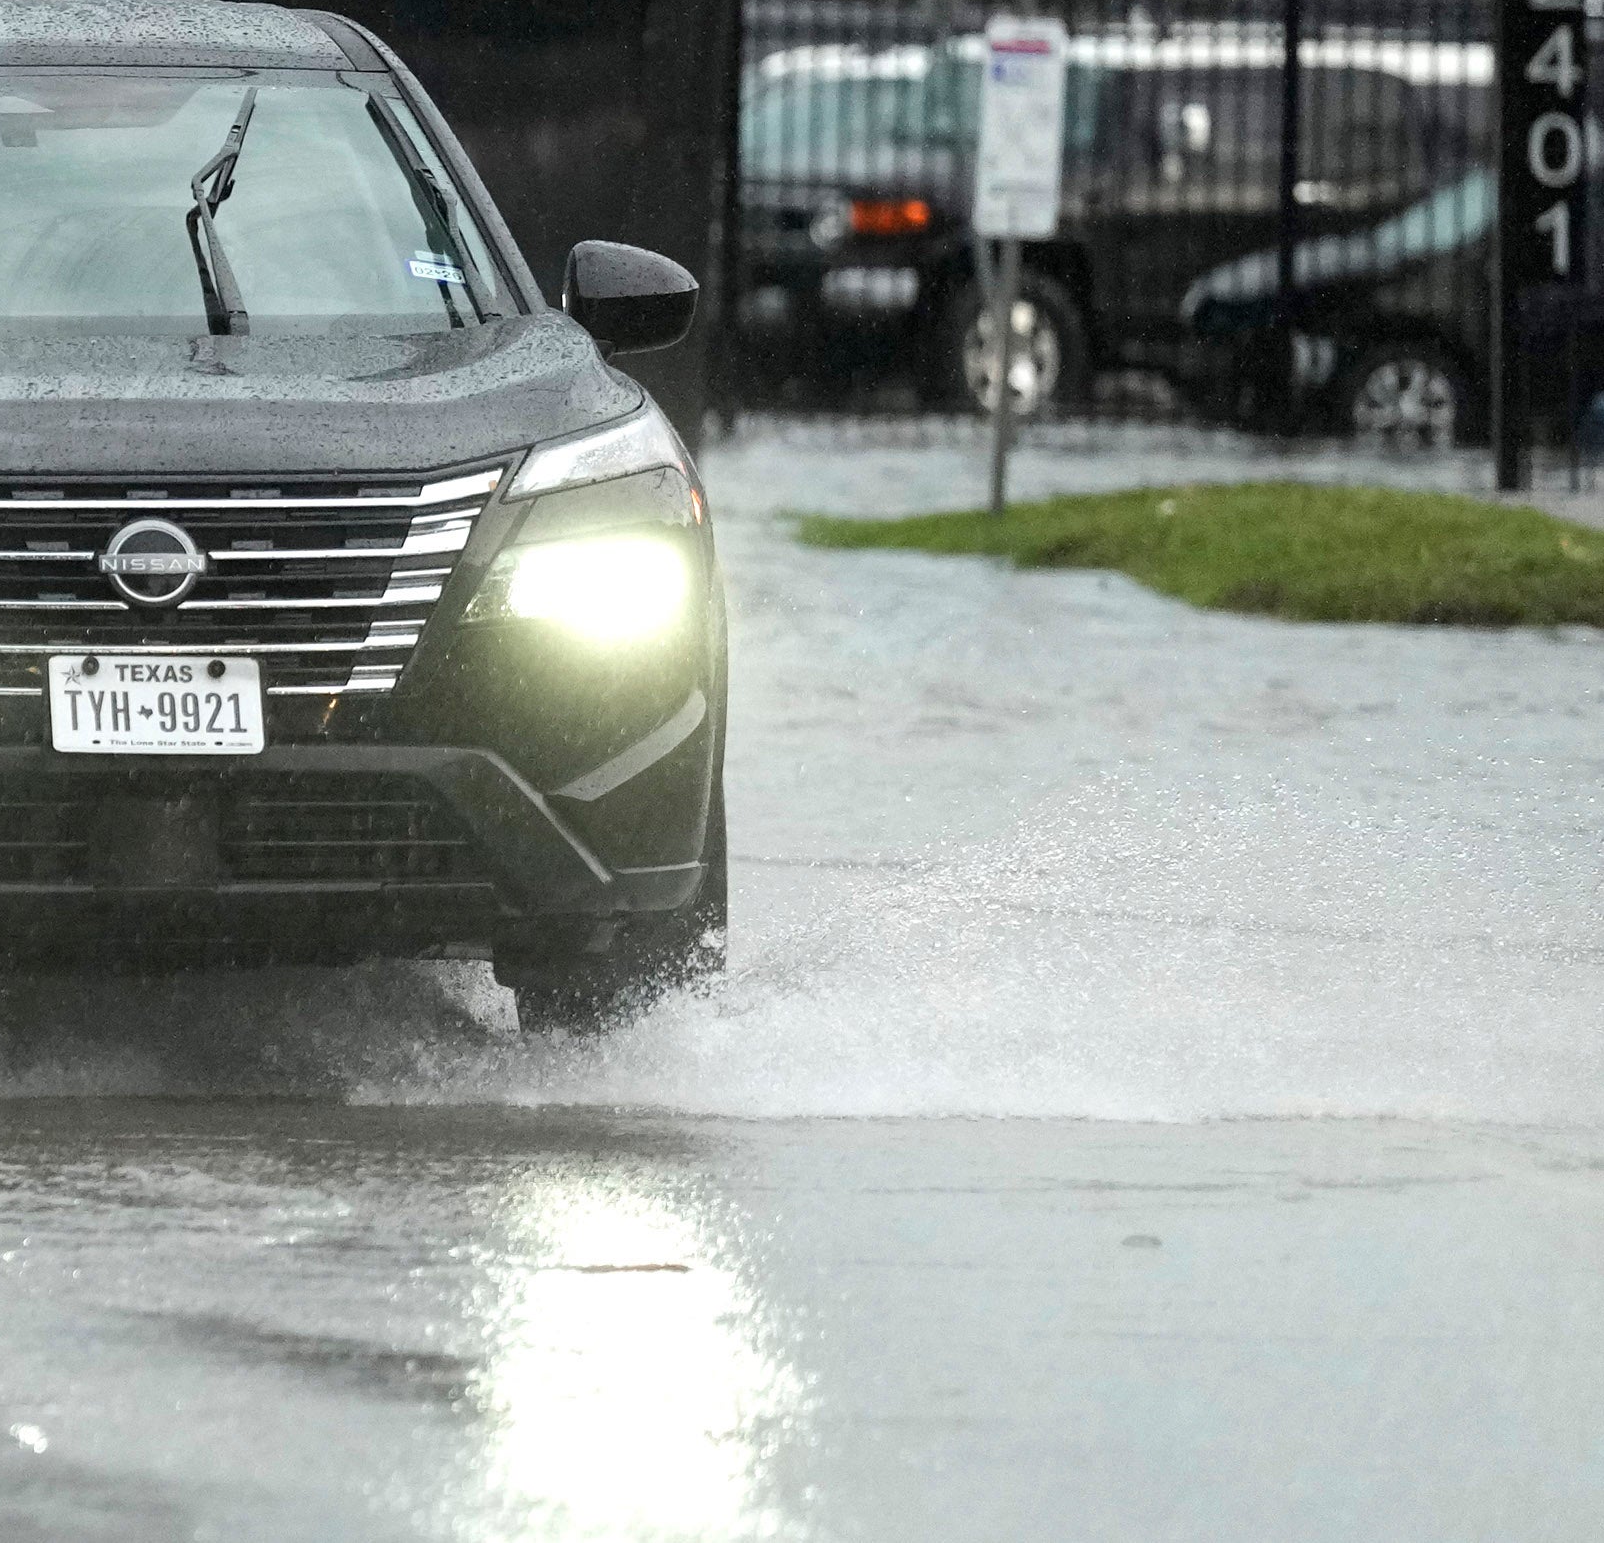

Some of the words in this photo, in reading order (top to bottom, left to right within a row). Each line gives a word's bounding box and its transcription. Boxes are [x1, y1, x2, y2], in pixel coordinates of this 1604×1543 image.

[101, 558, 204, 571] NISSAN
[115, 664, 193, 683] TEXAS
[131, 739, 154, 747] Lone
[157, 740, 177, 748] Star
[181, 740, 206, 748] State
